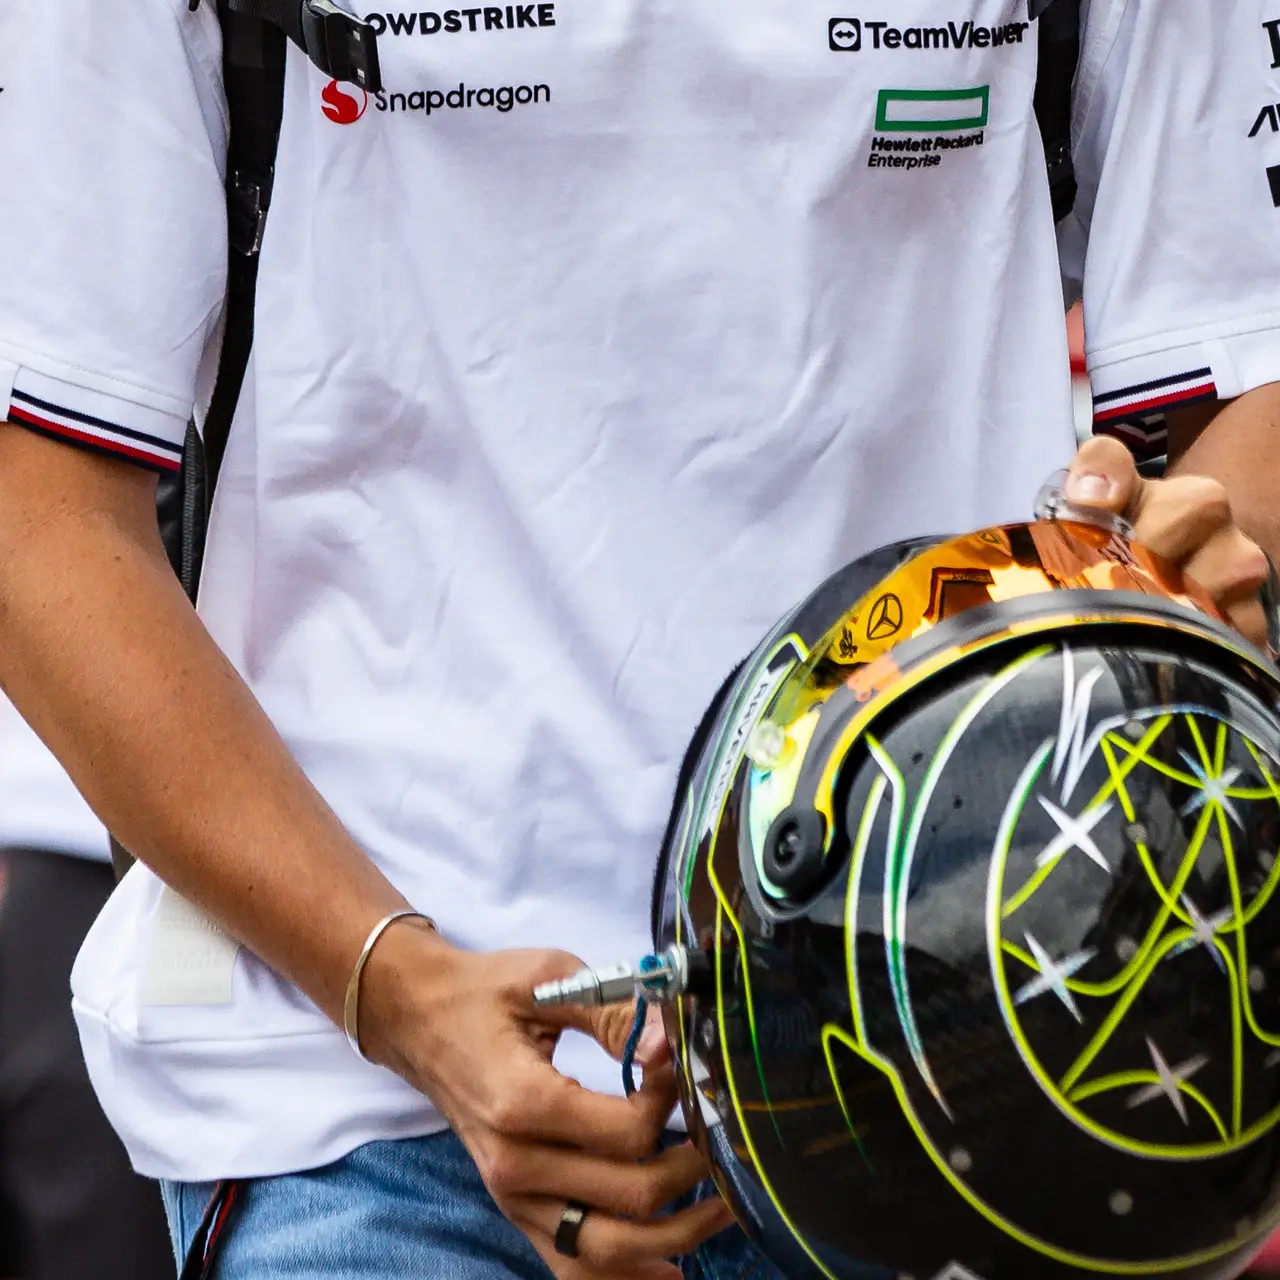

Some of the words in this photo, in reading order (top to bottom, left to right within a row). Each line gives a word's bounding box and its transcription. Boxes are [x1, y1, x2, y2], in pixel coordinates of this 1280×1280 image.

[864, 20, 1029, 49] TeamViewer
[374, 82, 551, 116] Snapdragon
[871, 136, 933, 152] Hewlett
[933, 130, 984, 150] Packard
[868, 153, 941, 170] Enterprise
